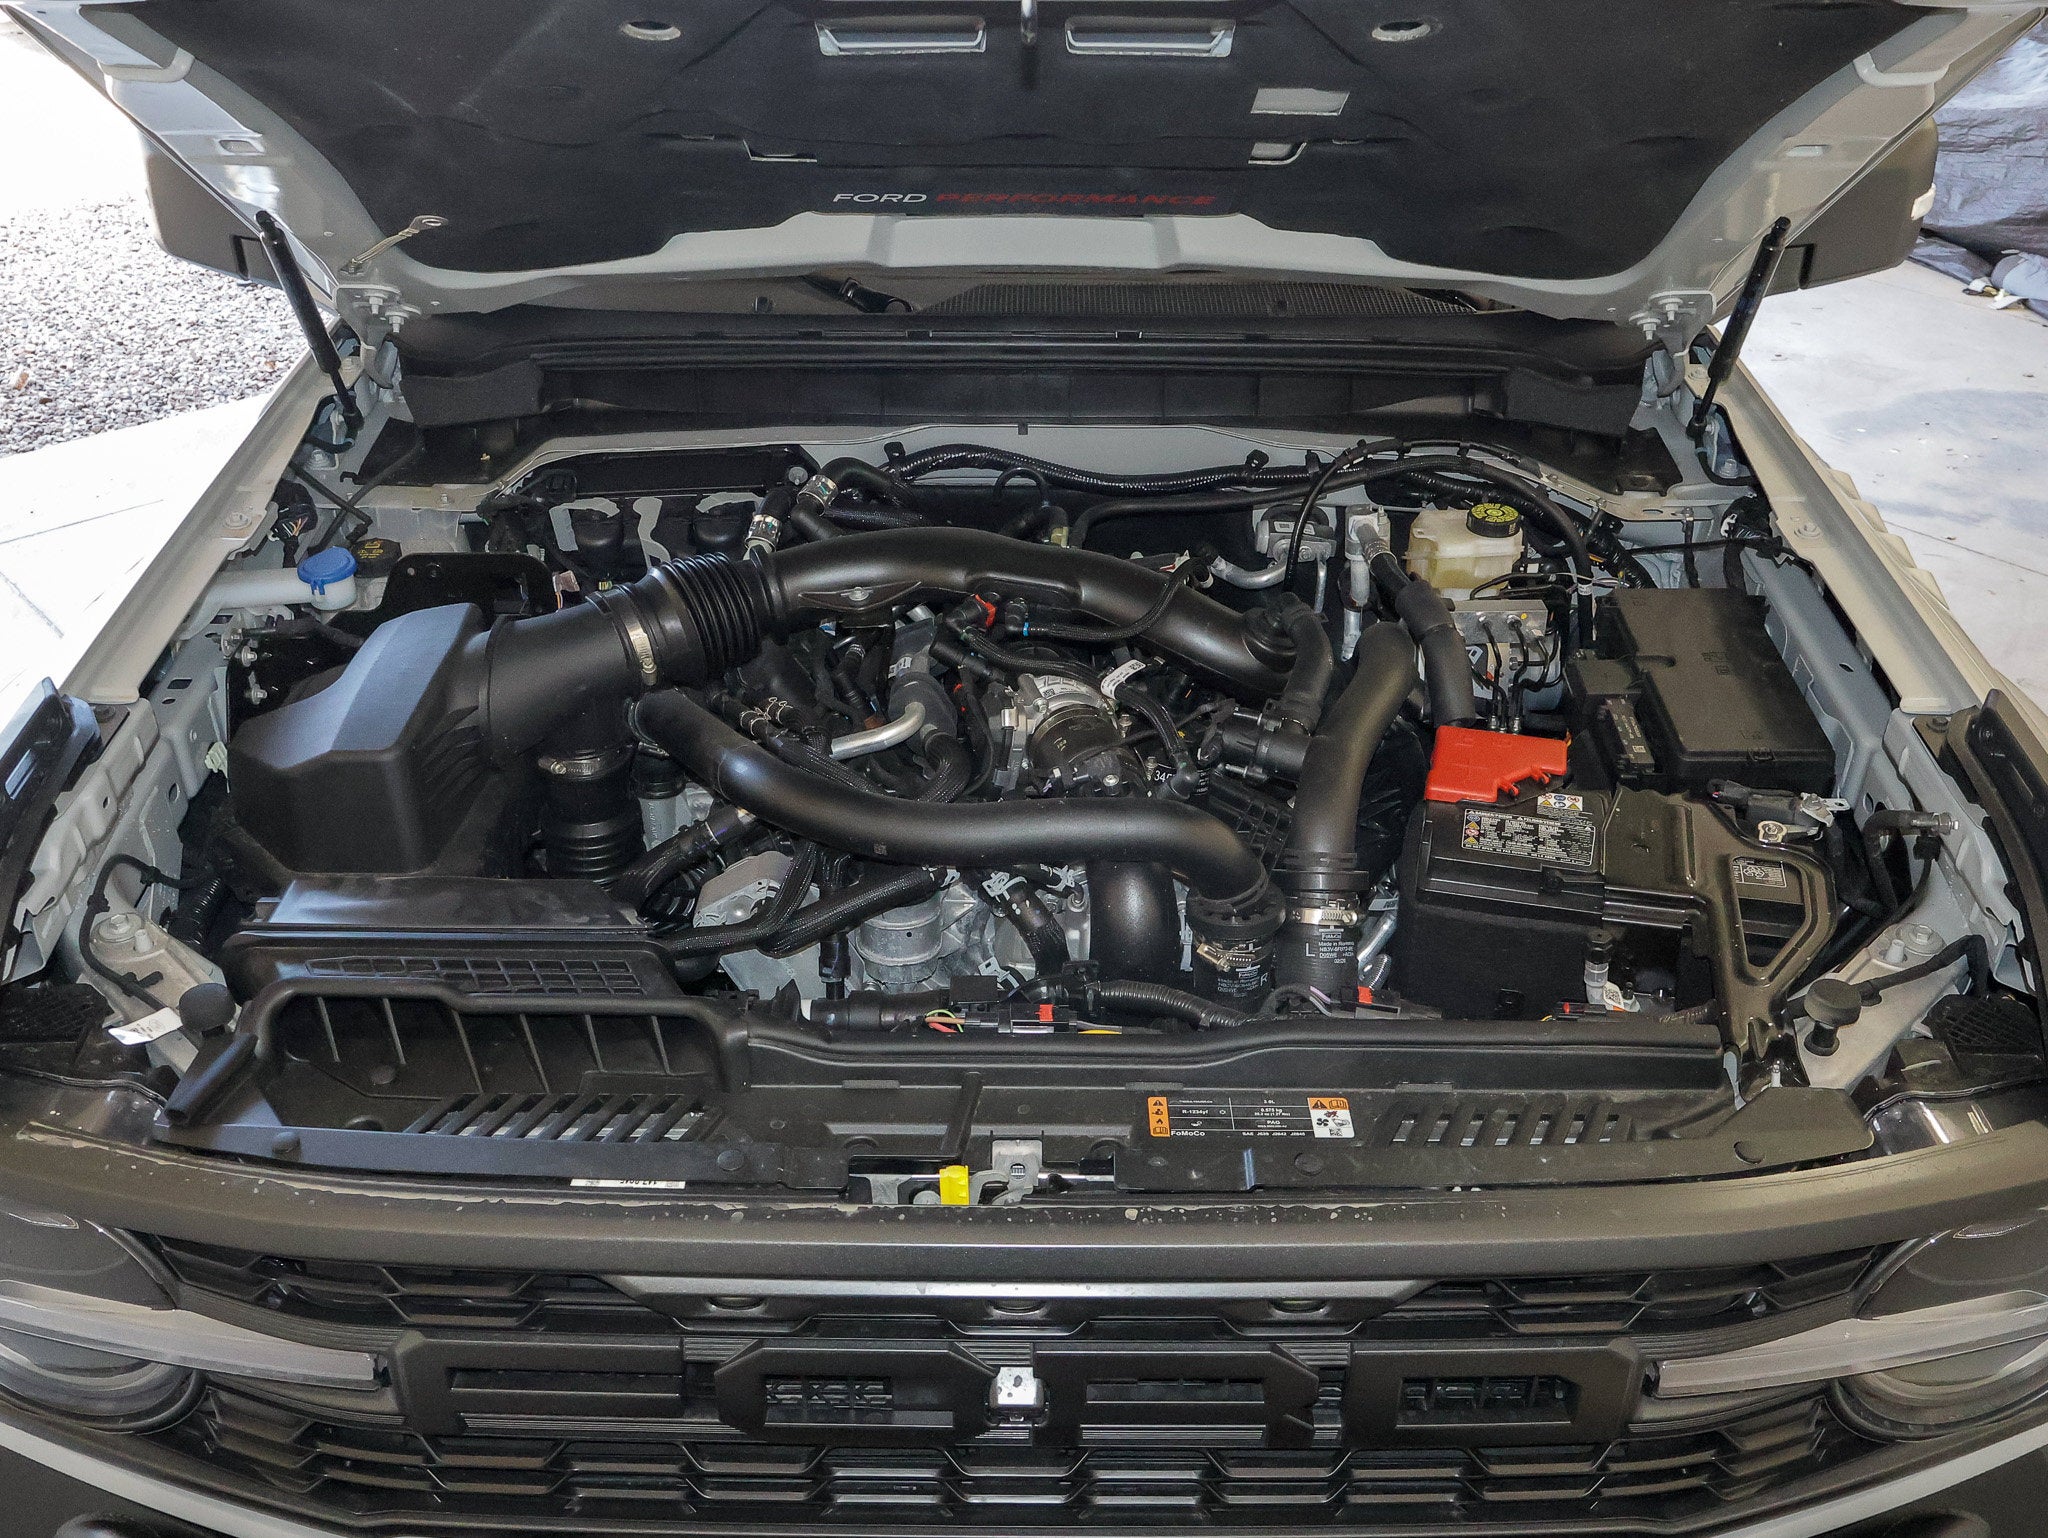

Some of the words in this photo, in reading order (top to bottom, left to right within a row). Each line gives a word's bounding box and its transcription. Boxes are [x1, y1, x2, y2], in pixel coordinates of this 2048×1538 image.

[832, 193, 927, 203] FORD
[937, 193, 1217, 206] PERFORMANCE
[1305, 942, 1315, 957] L
[1261, 973, 1268, 986] R
